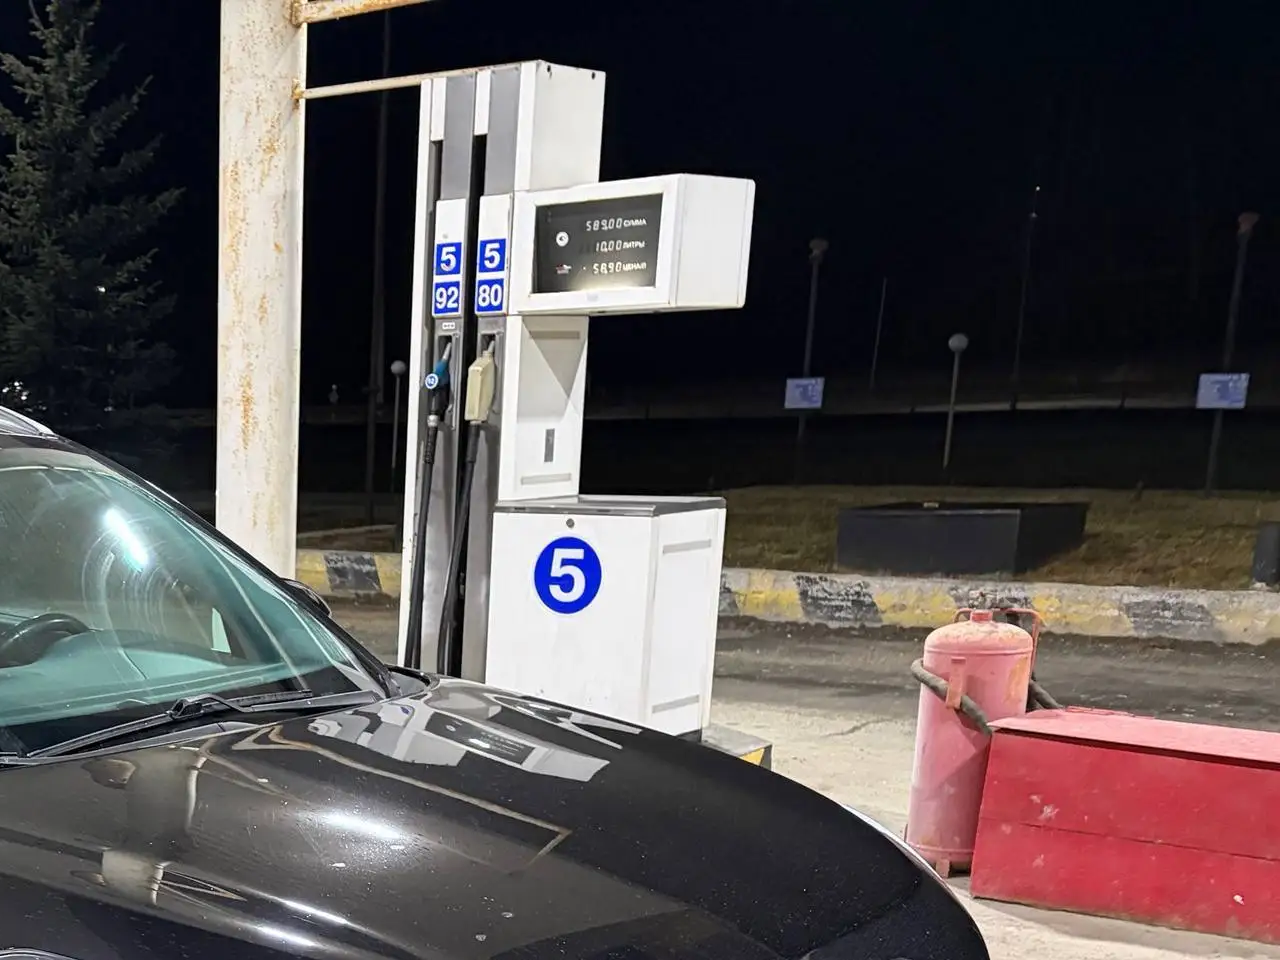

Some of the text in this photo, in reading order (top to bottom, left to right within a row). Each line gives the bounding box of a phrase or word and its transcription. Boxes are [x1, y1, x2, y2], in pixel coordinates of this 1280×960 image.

[440, 246, 456, 271] 5
[484, 243, 501, 268] 5
[435, 286, 458, 309] 92
[478, 284, 502, 307] 80
[548, 547, 586, 603] 5
